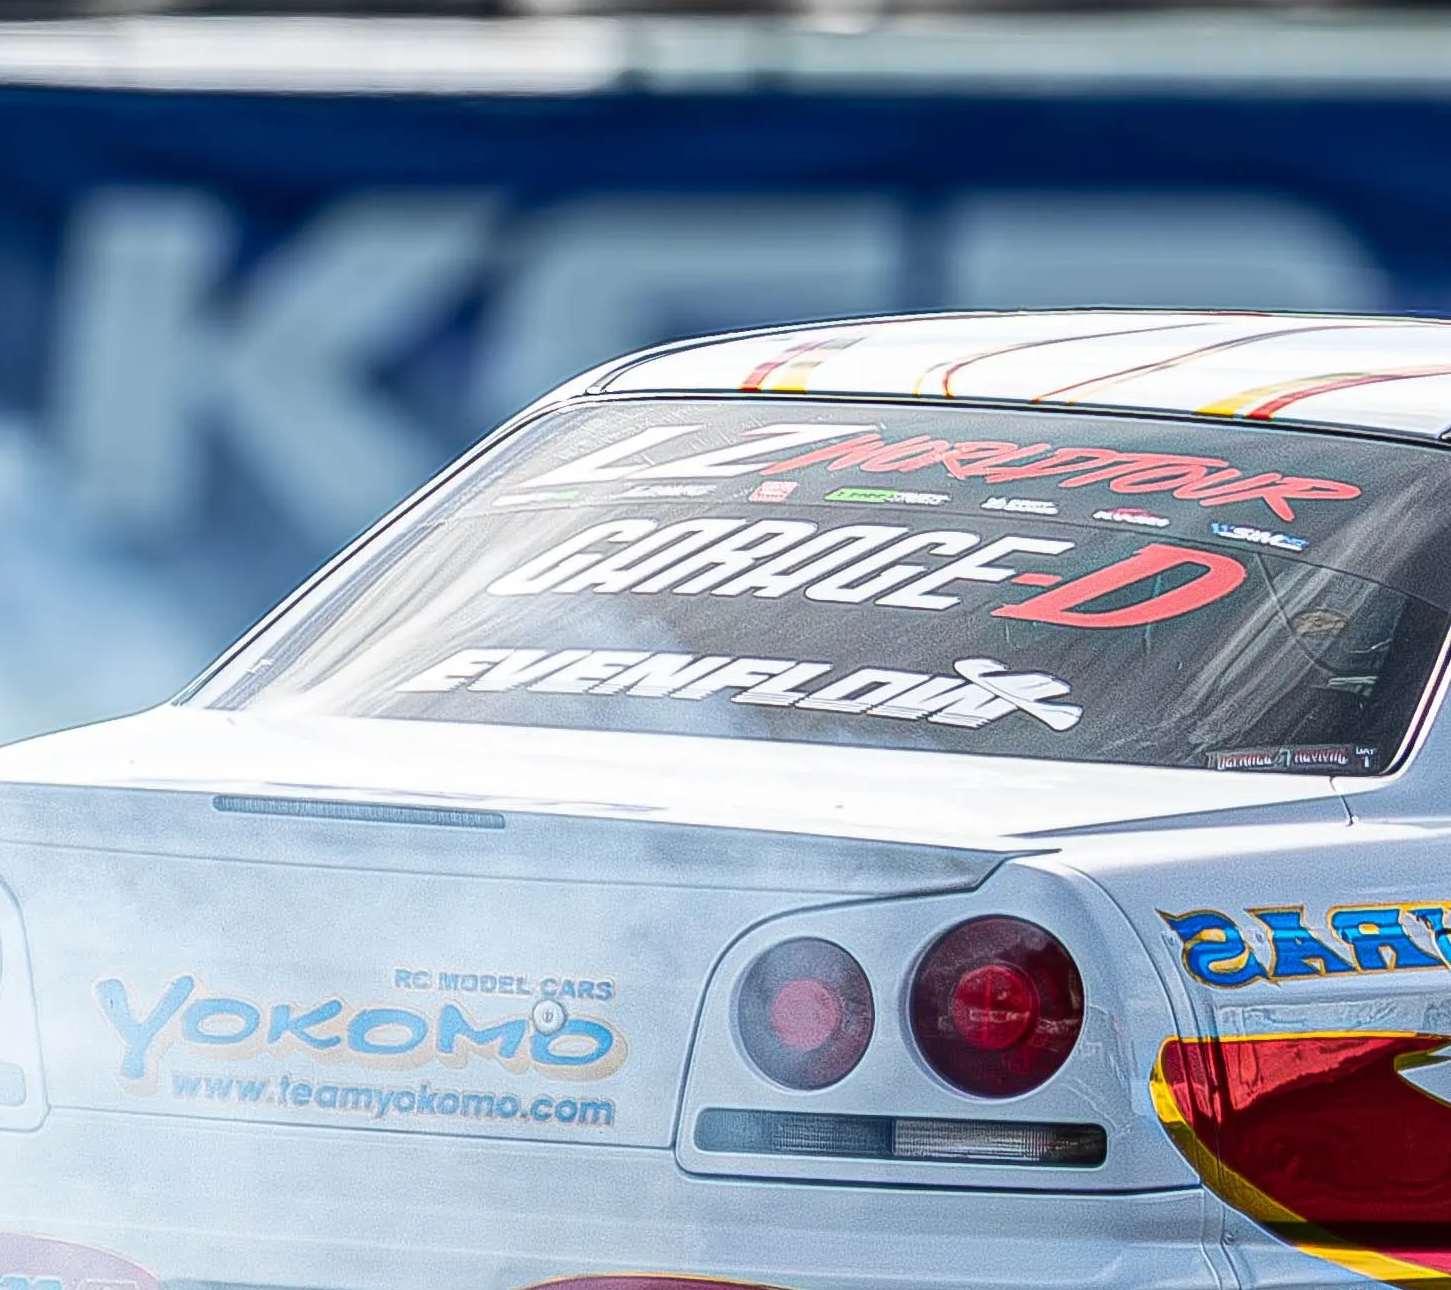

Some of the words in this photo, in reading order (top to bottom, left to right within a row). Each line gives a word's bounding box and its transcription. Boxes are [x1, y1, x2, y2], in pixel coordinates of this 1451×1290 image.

[514, 422, 881, 491] LZ
[393, 967, 431, 990] RC
[438, 971, 529, 998] MODEL
[539, 976, 614, 1002] CARS
[170, 1071, 616, 1127] www.teamyokomo.com
